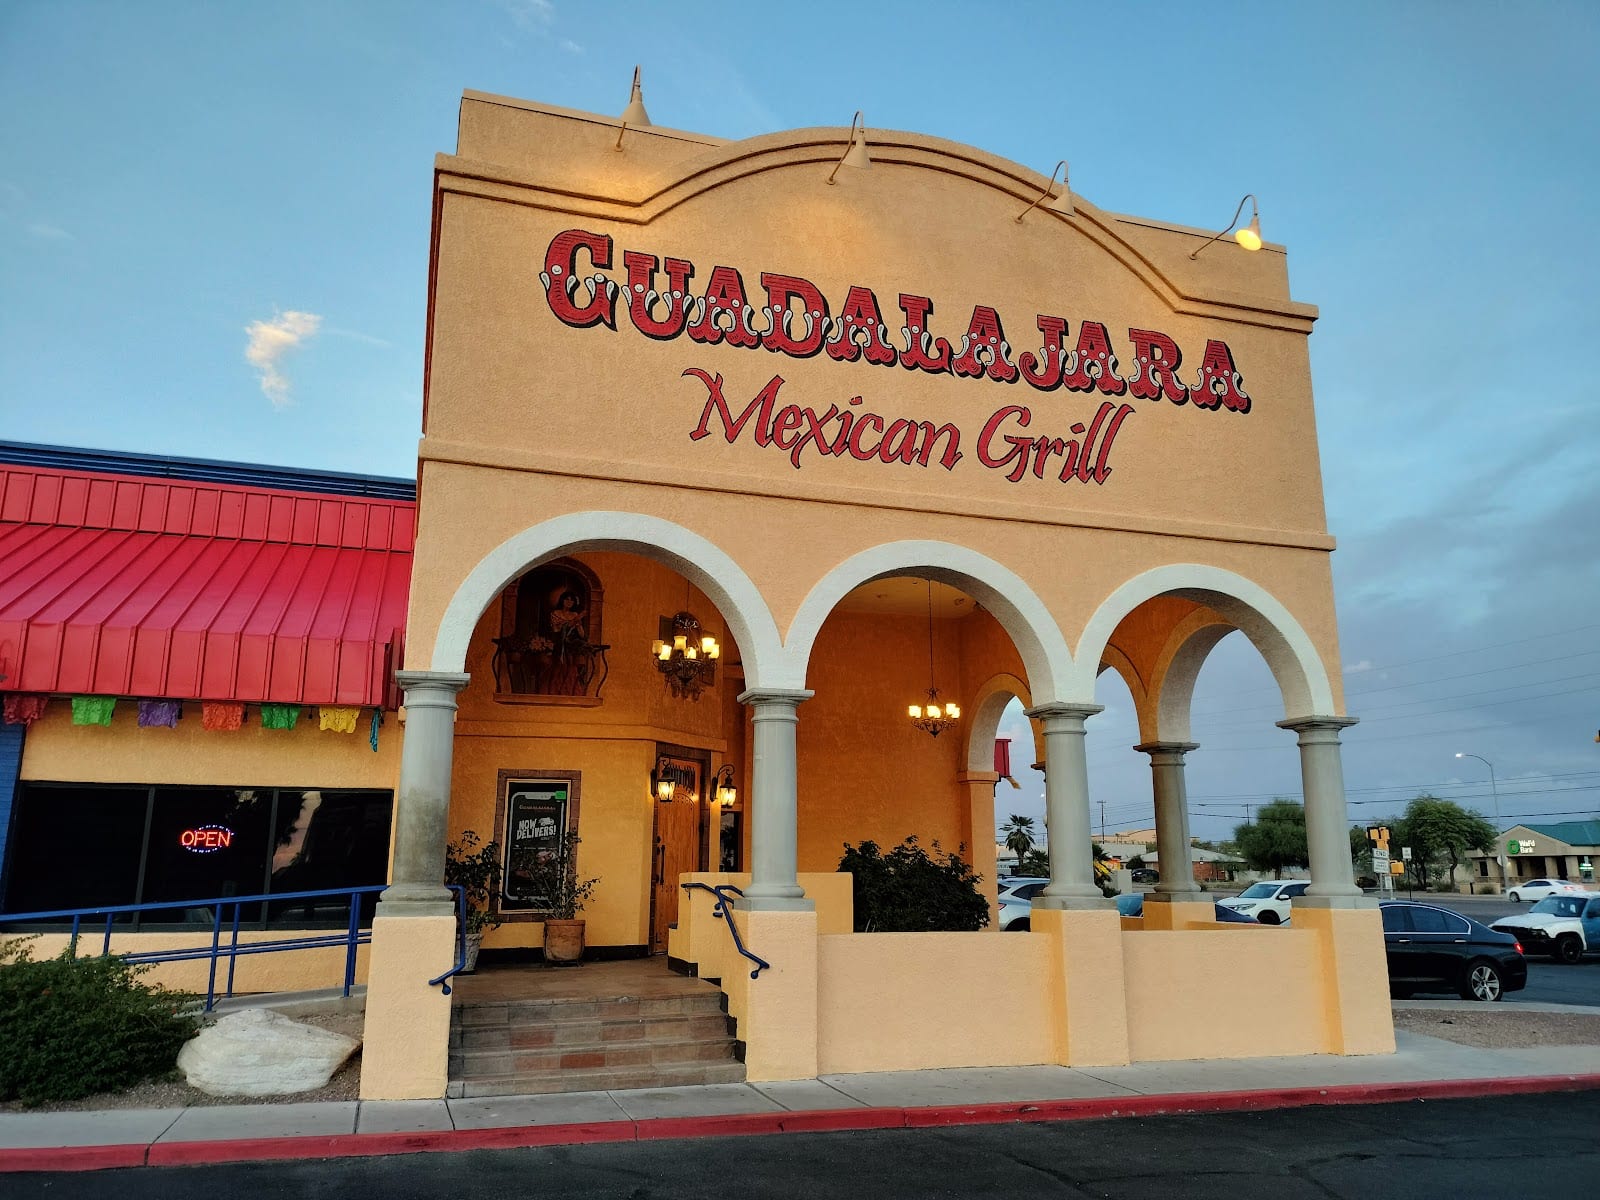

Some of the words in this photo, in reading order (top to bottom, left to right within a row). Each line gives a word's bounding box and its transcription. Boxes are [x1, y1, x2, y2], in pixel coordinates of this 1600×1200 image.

[538, 228, 1252, 414] GUADALAJARA
[681, 367, 963, 470] Mexican
[976, 401, 1136, 486] Grill
[518, 818, 537, 830] NOW
[181, 830, 231, 847] OPEN
[516, 825, 556, 840] DELIVERS!
[1520, 846, 1534, 854] Bank
